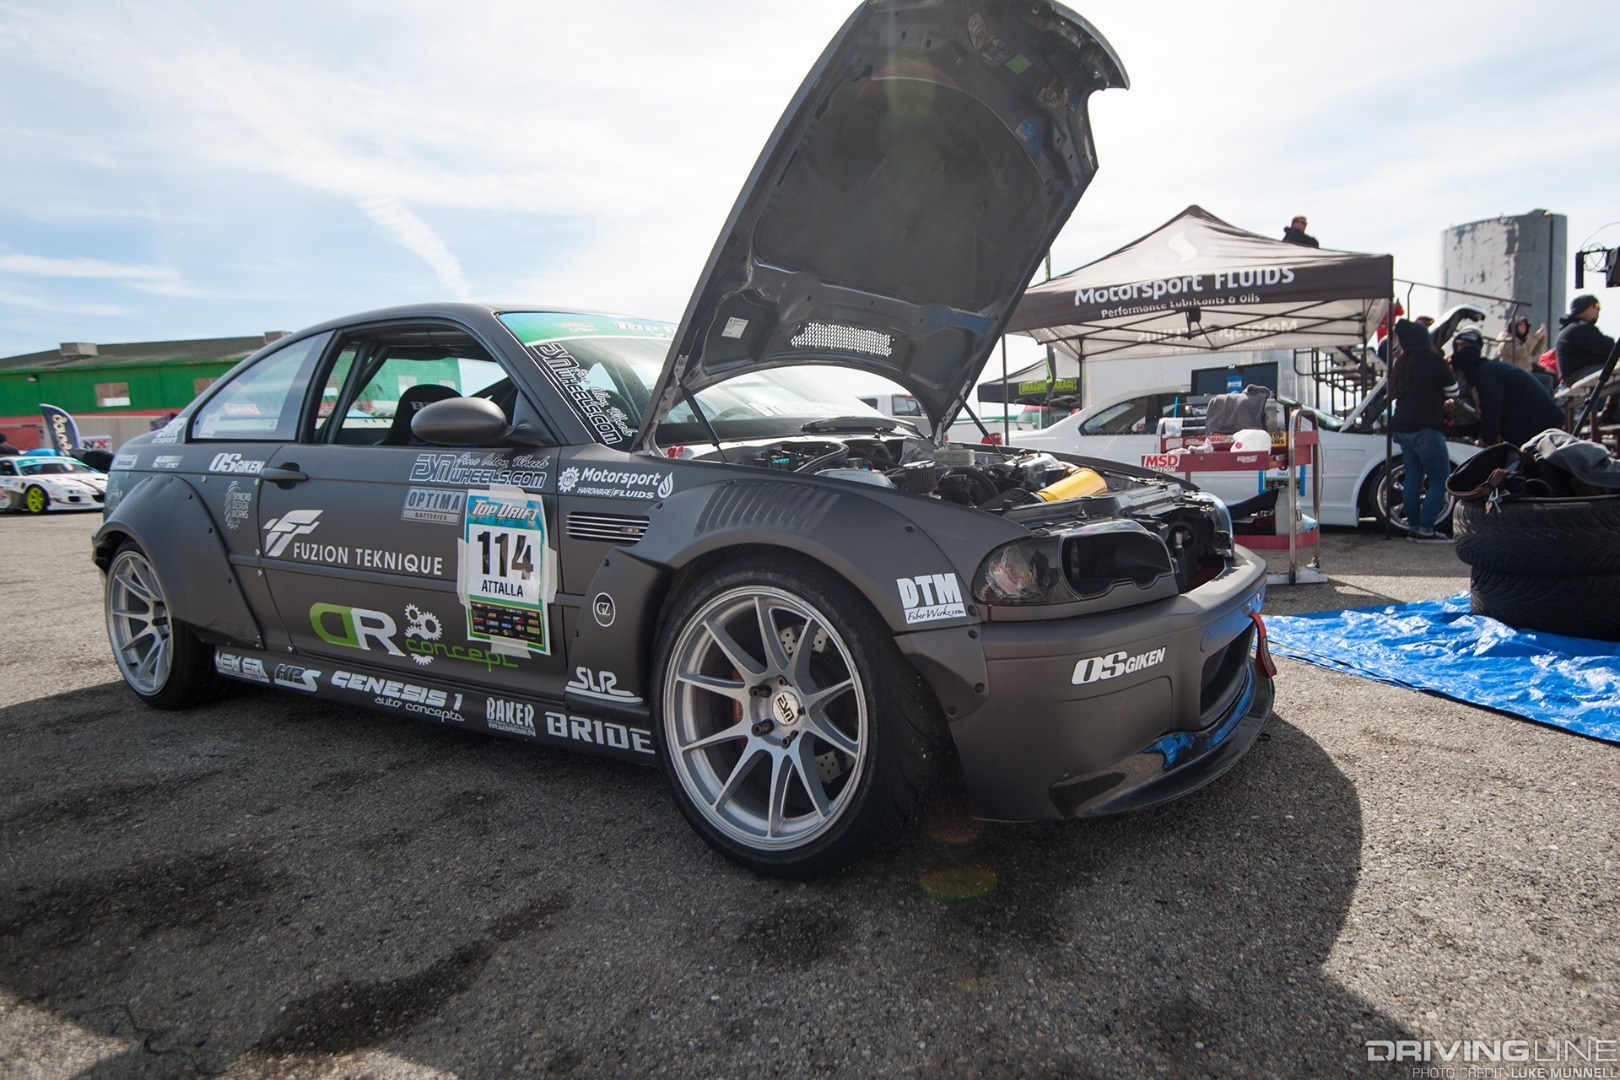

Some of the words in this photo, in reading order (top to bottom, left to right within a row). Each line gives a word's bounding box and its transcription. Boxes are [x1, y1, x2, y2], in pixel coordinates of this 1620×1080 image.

[1075, 274, 1202, 306] Motorsport
[1214, 266, 1295, 289] FLUIDS
[1101, 302, 1167, 318] Performance
[1239, 293, 1260, 303] Oils
[1145, 455, 1179, 467] MSD
[580, 467, 661, 488] Motorsport
[407, 491, 461, 511] OPTIMA
[414, 512, 448, 521] BATTERIES
[293, 542, 348, 565] FUZION
[356, 548, 443, 576] TEKNIQUE
[477, 531, 535, 581] 114
[481, 579, 524, 598] ATTALLA
[896, 572, 963, 610] DTM
[331, 670, 448, 708] GENESIS
[453, 692, 464, 712] 1
[567, 666, 636, 698] SLR
[374, 696, 402, 709] auto
[405, 703, 465, 723] concepts
[486, 697, 535, 728] BAKER
[545, 711, 656, 755] BRIDE
